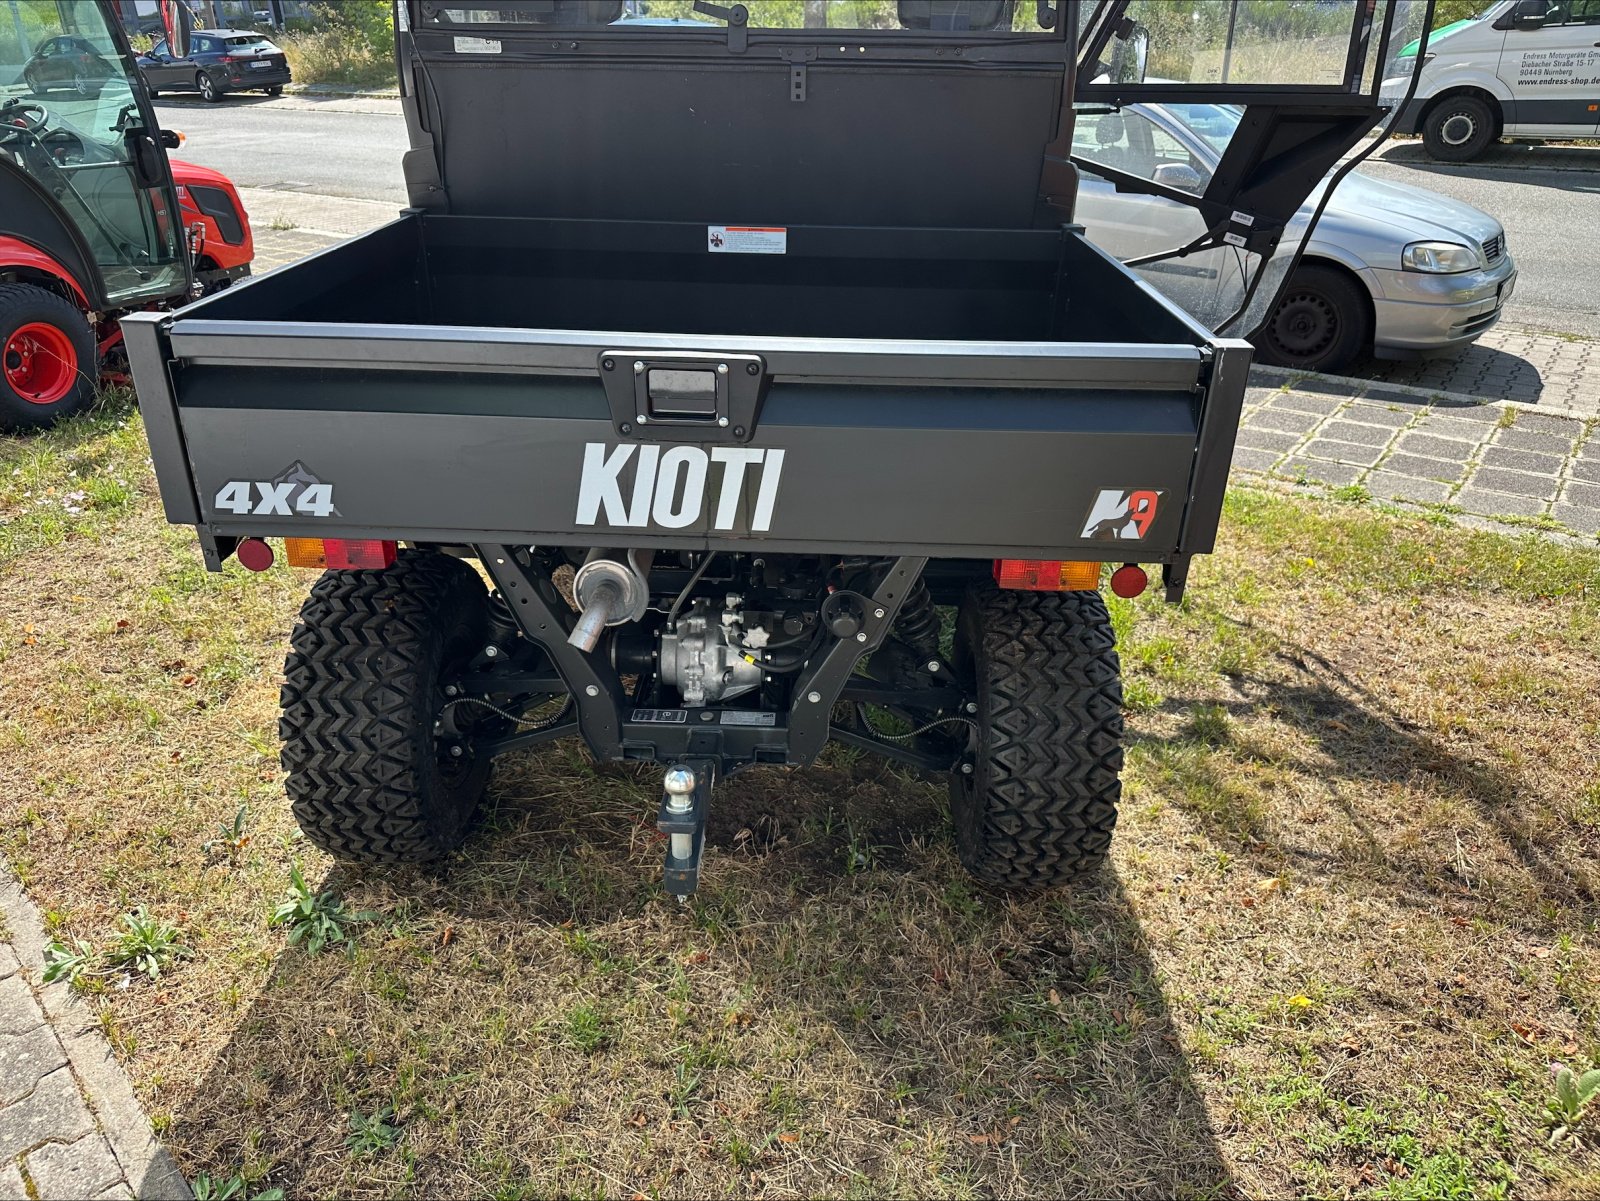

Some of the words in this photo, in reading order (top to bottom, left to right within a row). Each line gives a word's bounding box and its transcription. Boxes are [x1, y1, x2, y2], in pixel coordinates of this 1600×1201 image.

[1523, 52, 1547, 60] Endress
[1548, 51, 1587, 60] Motorgeräte
[1521, 60, 1552, 68] Diebacher
[1576, 59, 1595, 67] 15-17
[1520, 68, 1543, 76] 90449
[1543, 68, 1573, 76] Nürnberg
[1517, 76, 1600, 86] www.endress-shop.de
[575, 442, 785, 532] KIOTI
[1080, 489, 1164, 539] K9
